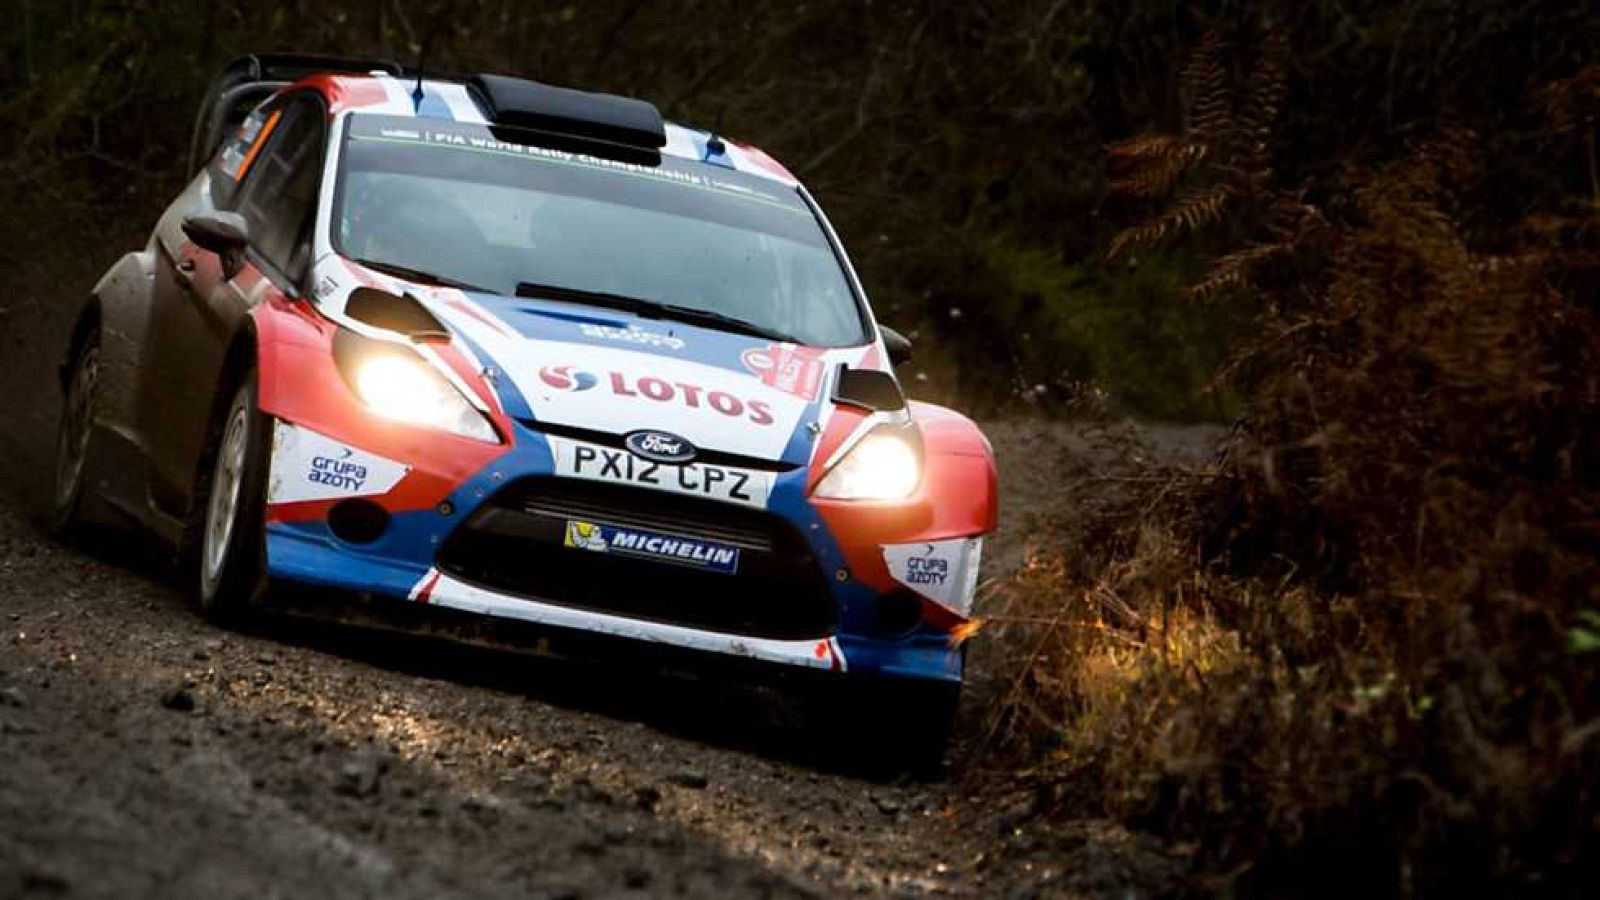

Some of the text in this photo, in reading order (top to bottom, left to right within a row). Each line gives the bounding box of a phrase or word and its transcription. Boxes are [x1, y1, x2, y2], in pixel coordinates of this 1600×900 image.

[436, 132, 466, 145] FIA
[528, 147, 572, 161] Rally
[610, 372, 774, 425] LOTOS
[641, 435, 682, 455] Ford
[574, 446, 750, 500] PX12 CPZ
[612, 533, 734, 563] MICHELIN
